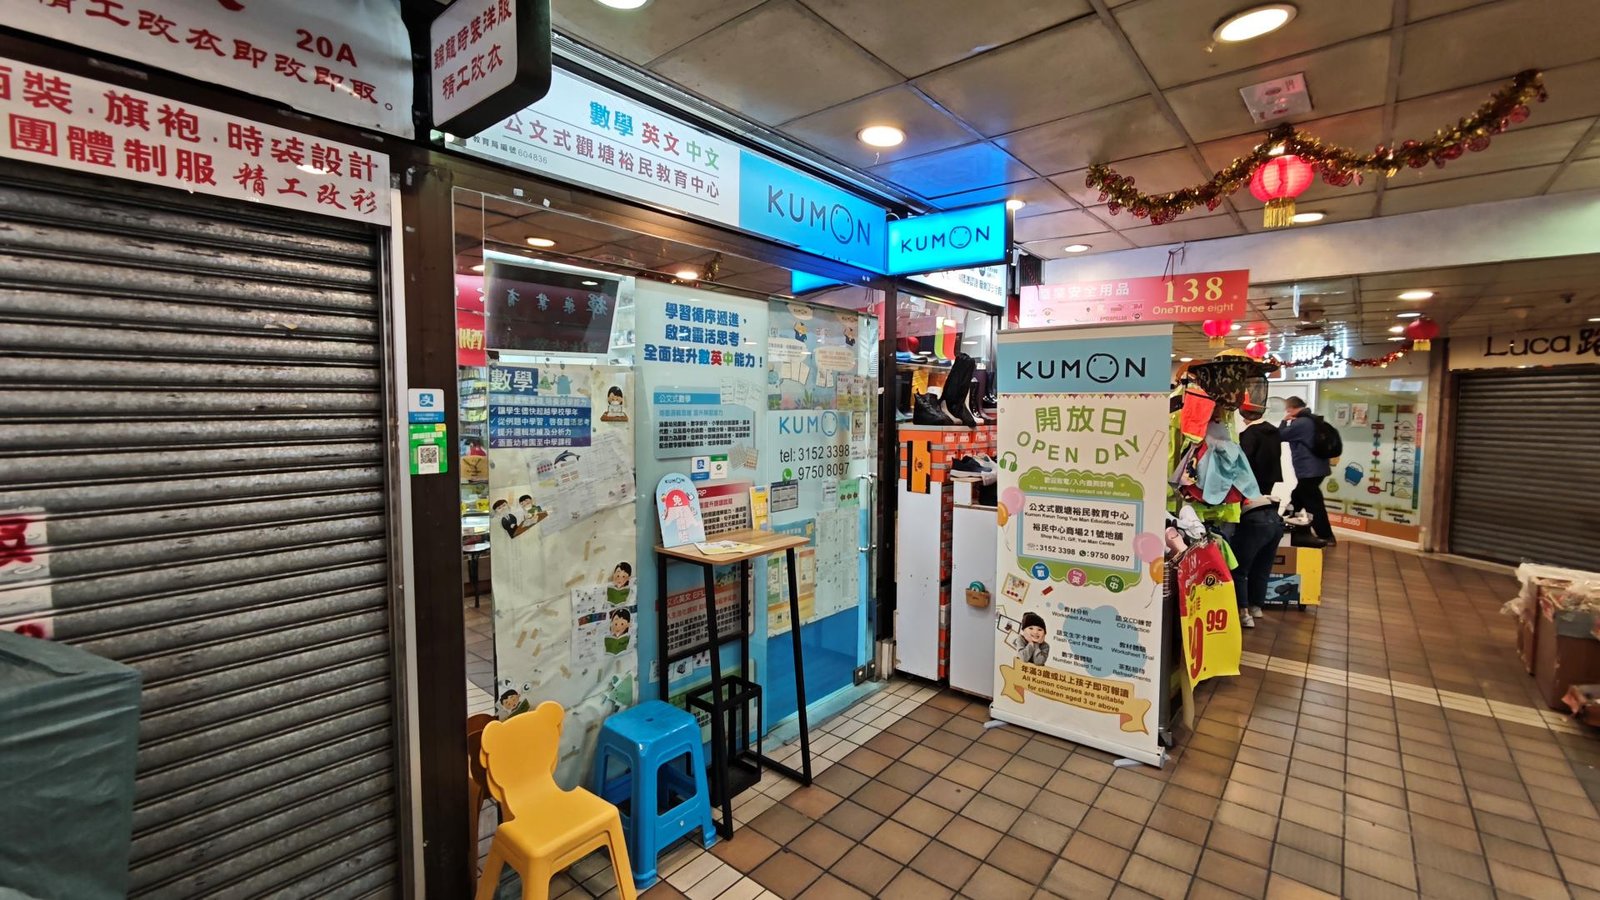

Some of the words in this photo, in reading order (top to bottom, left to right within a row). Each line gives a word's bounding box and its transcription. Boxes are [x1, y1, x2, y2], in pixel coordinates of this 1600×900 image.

[296, 28, 358, 68] 20A
[443, 44, 503, 100] 精工改衣
[589, 100, 634, 137] 數學
[641, 121, 681, 156] 英文
[686, 140, 720, 171] 中文
[9, 113, 217, 188] 團體制服
[503, 114, 720, 199] 公文式觀塘裕民教育中心
[767, 185, 871, 247] KUMON
[901, 225, 990, 254] KUMON
[1165, 277, 1224, 303] 138
[1207, 302, 1234, 314] eight
[1484, 336, 1571, 356] Luca
[490, 368, 533, 392] 數學
[1016, 353, 1146, 383] KUMON
[779, 410, 850, 437] KUMON
[1035, 405, 1127, 436] 開放日
[780, 448, 796, 463] tel:
[798, 448, 824, 462] 3152
[826, 444, 850, 459] 3398
[1016, 431, 1079, 464] OPEN
[1095, 434, 1142, 465] DAY
[798, 465, 824, 481] 9750
[826, 462, 850, 477] 8097
[1029, 502, 1130, 520] 公文式觀塘裕民教育中心
[1058, 546, 1076, 555] 3398
[1111, 553, 1130, 562] 8097
[1109, 581, 1119, 590] 中
[1206, 608, 1228, 633] 99
[1027, 683, 1036, 691] for
[1037, 686, 1064, 698] children
[1065, 694, 1082, 703] aged
[1097, 701, 1120, 713] above
[1032, 677, 1055, 688] Kumon
[1056, 683, 1082, 695] courses
[1084, 690, 1095, 698] are
[1096, 692, 1125, 706] suitable
